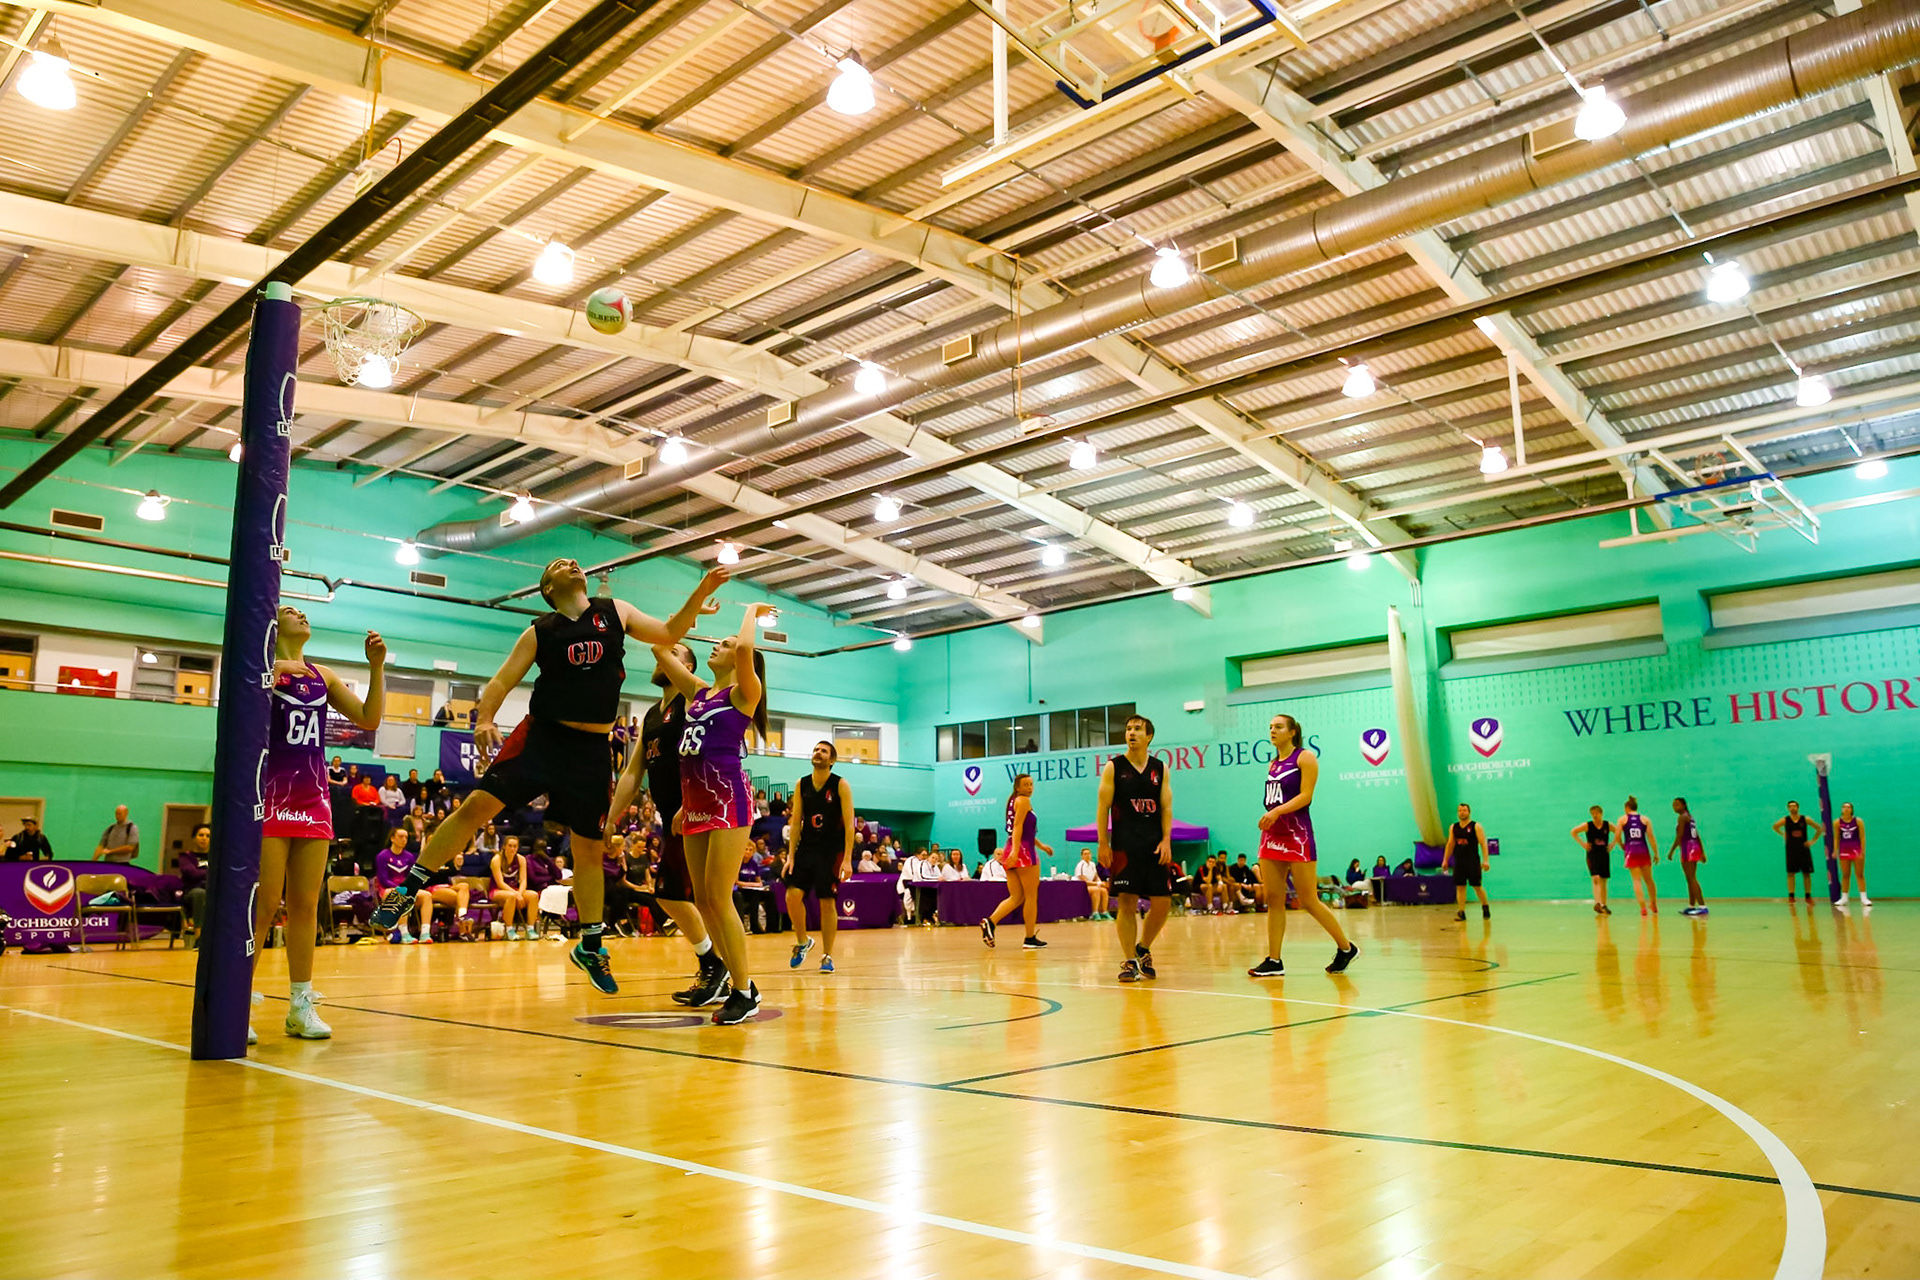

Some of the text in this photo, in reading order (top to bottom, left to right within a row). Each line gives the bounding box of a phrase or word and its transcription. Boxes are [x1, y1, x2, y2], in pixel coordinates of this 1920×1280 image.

[567, 640, 604, 666] GD
[1563, 675, 1920, 737] WHERE HISTOR
[286, 709, 320, 748] GA
[678, 724, 706, 757] GS
[1004, 734, 1321, 784] WHERE HORY BEGS
[1447, 758, 1531, 773] LOUGHBOROUGH
[1465, 771, 1514, 781] SPORT
[1265, 782, 1284, 806] WA
[1130, 798, 1157, 814] WD
[276, 807, 312, 826] Vitality
[811, 813, 823, 829] C
[7, 916, 110, 929] UGHBOROUGH
[14, 931, 71, 940] SPOR
